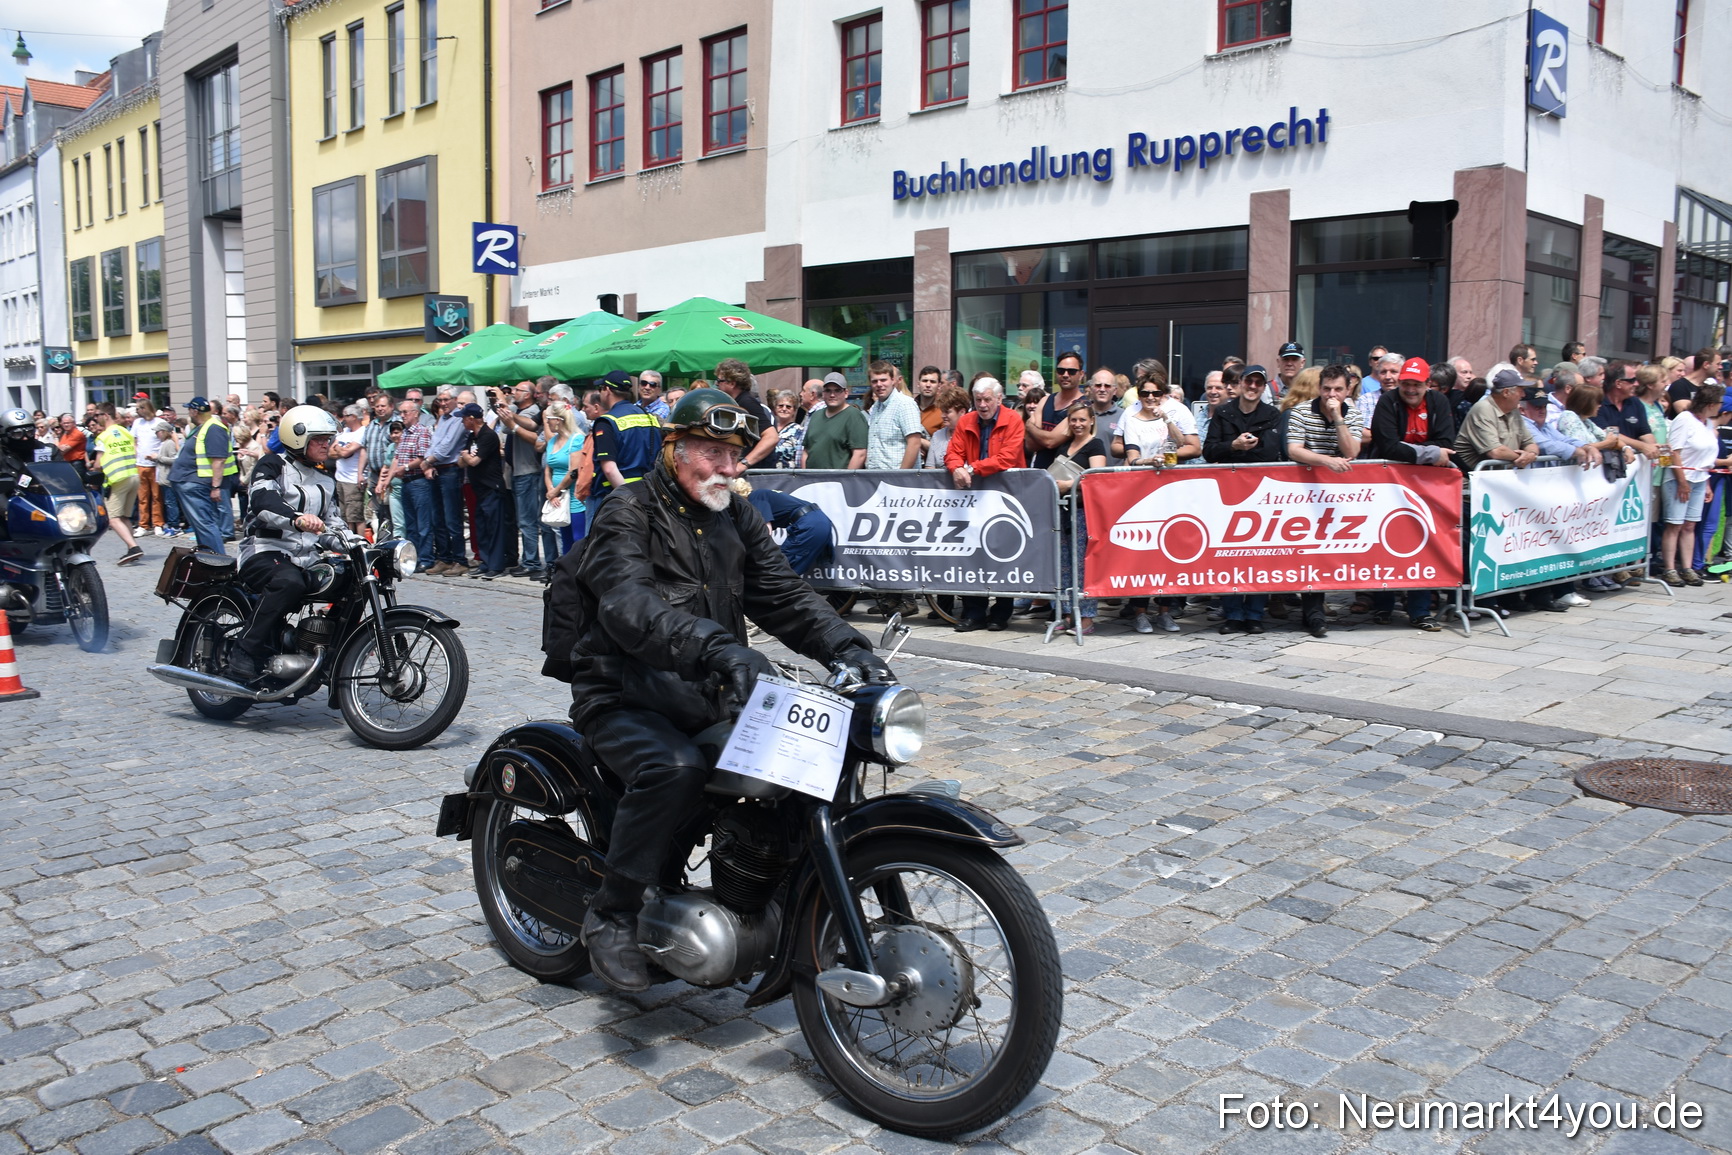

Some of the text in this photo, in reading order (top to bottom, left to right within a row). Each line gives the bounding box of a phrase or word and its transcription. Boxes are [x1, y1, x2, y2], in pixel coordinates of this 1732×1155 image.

[892, 106, 1330, 202] Buchhandlung Rupprecht
[522, 290, 539, 300] Unterer
[539, 287, 553, 297] Markt
[876, 494, 978, 509] Autoklassik
[1257, 488, 1376, 505] Autoklassik
[847, 511, 970, 544] Dietz
[1221, 507, 1368, 544] Dietz
[842, 547, 910, 557] BREITENBRUNN
[1213, 547, 1296, 558] BREITENBRUNN
[801, 564, 1035, 584] .autoklassik-dietz.de
[1109, 562, 1437, 589] www.autoklassik-dietz.de
[787, 703, 831, 733] 680
